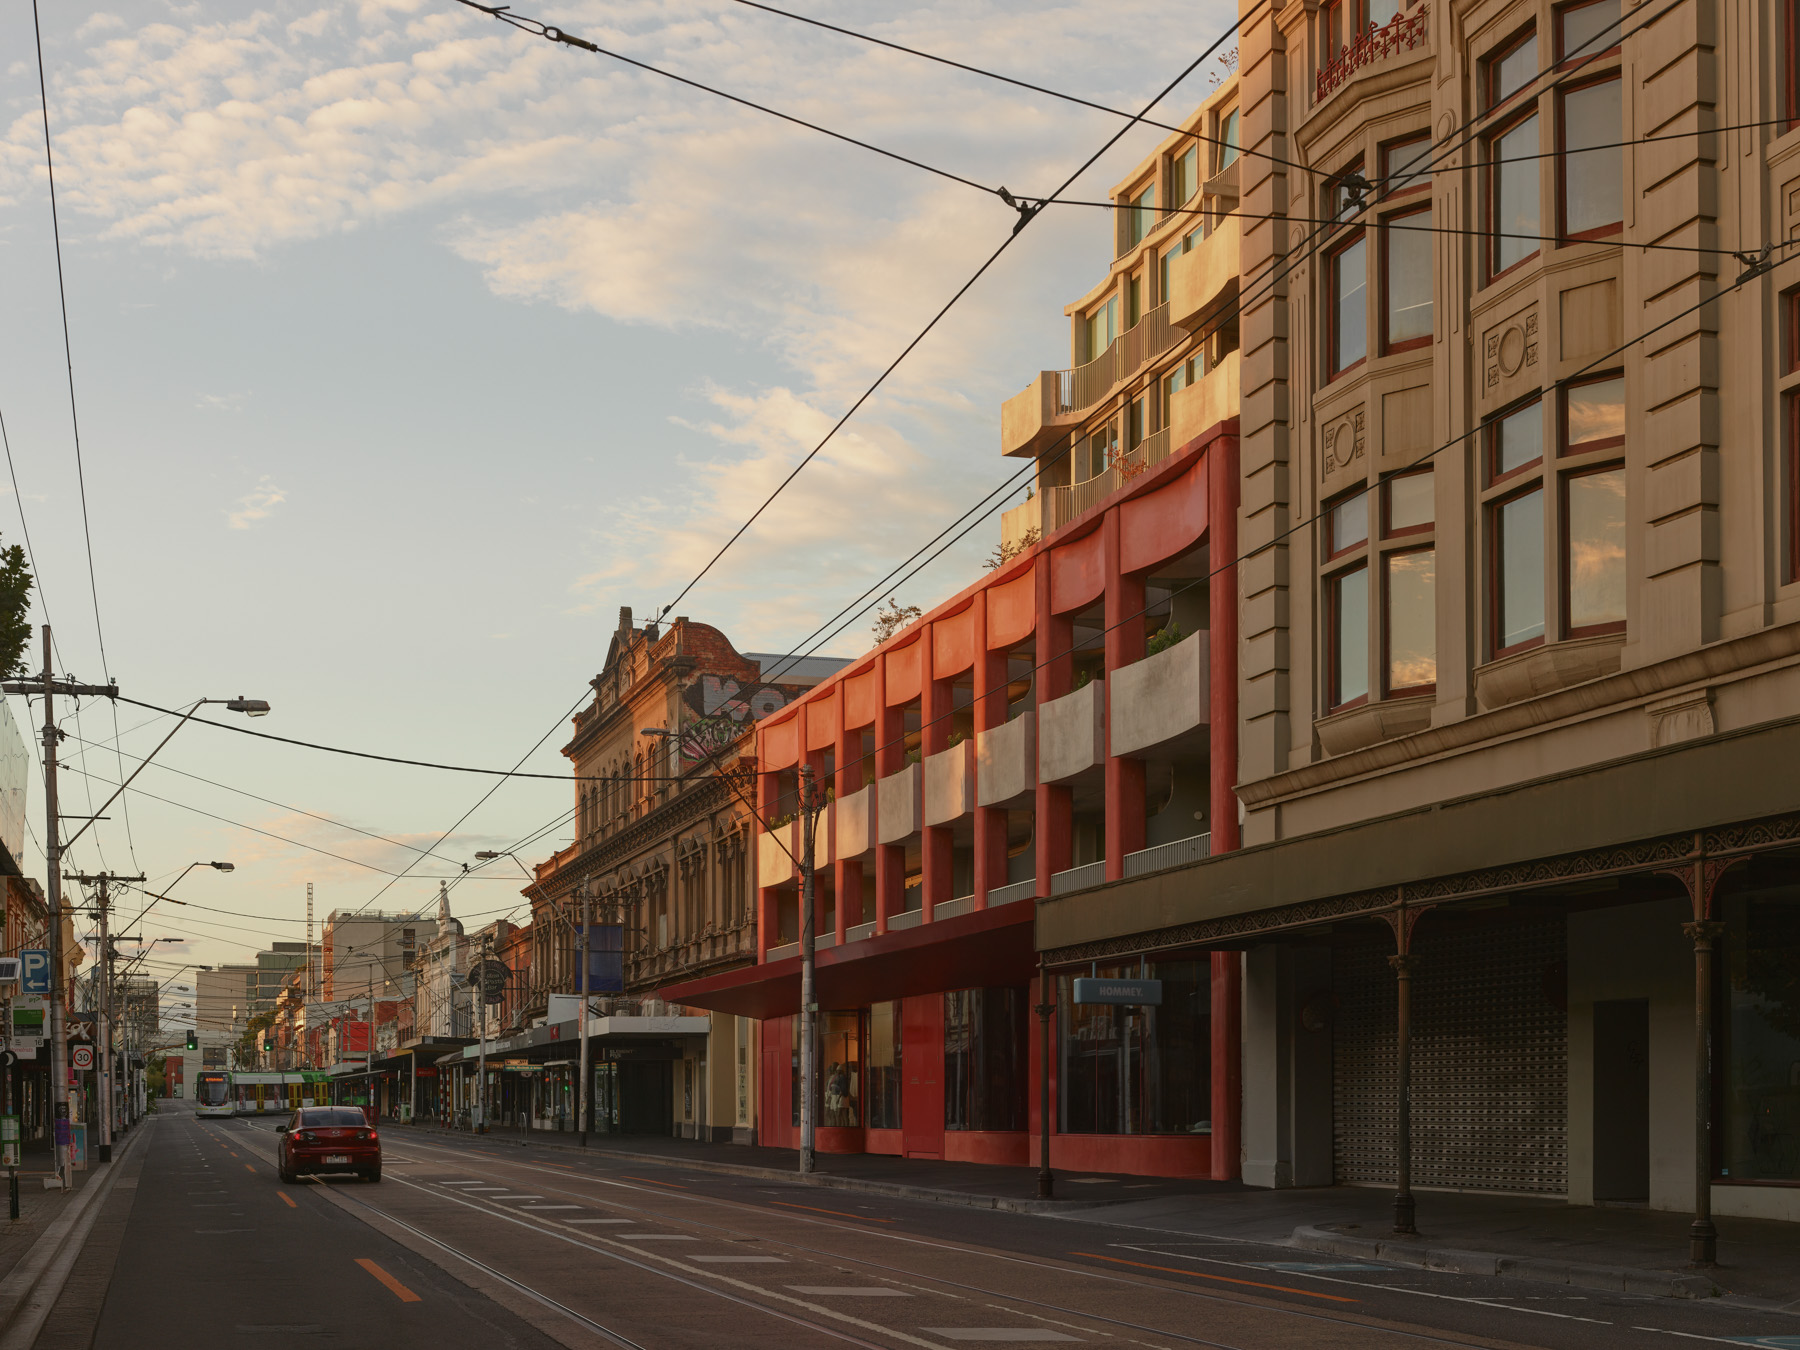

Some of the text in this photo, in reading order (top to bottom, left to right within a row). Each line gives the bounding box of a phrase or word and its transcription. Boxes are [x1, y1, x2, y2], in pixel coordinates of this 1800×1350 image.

[25, 954, 45, 978] P
[1099, 986, 1143, 997] HOMMEY.
[77, 1053, 89, 1062] 30
